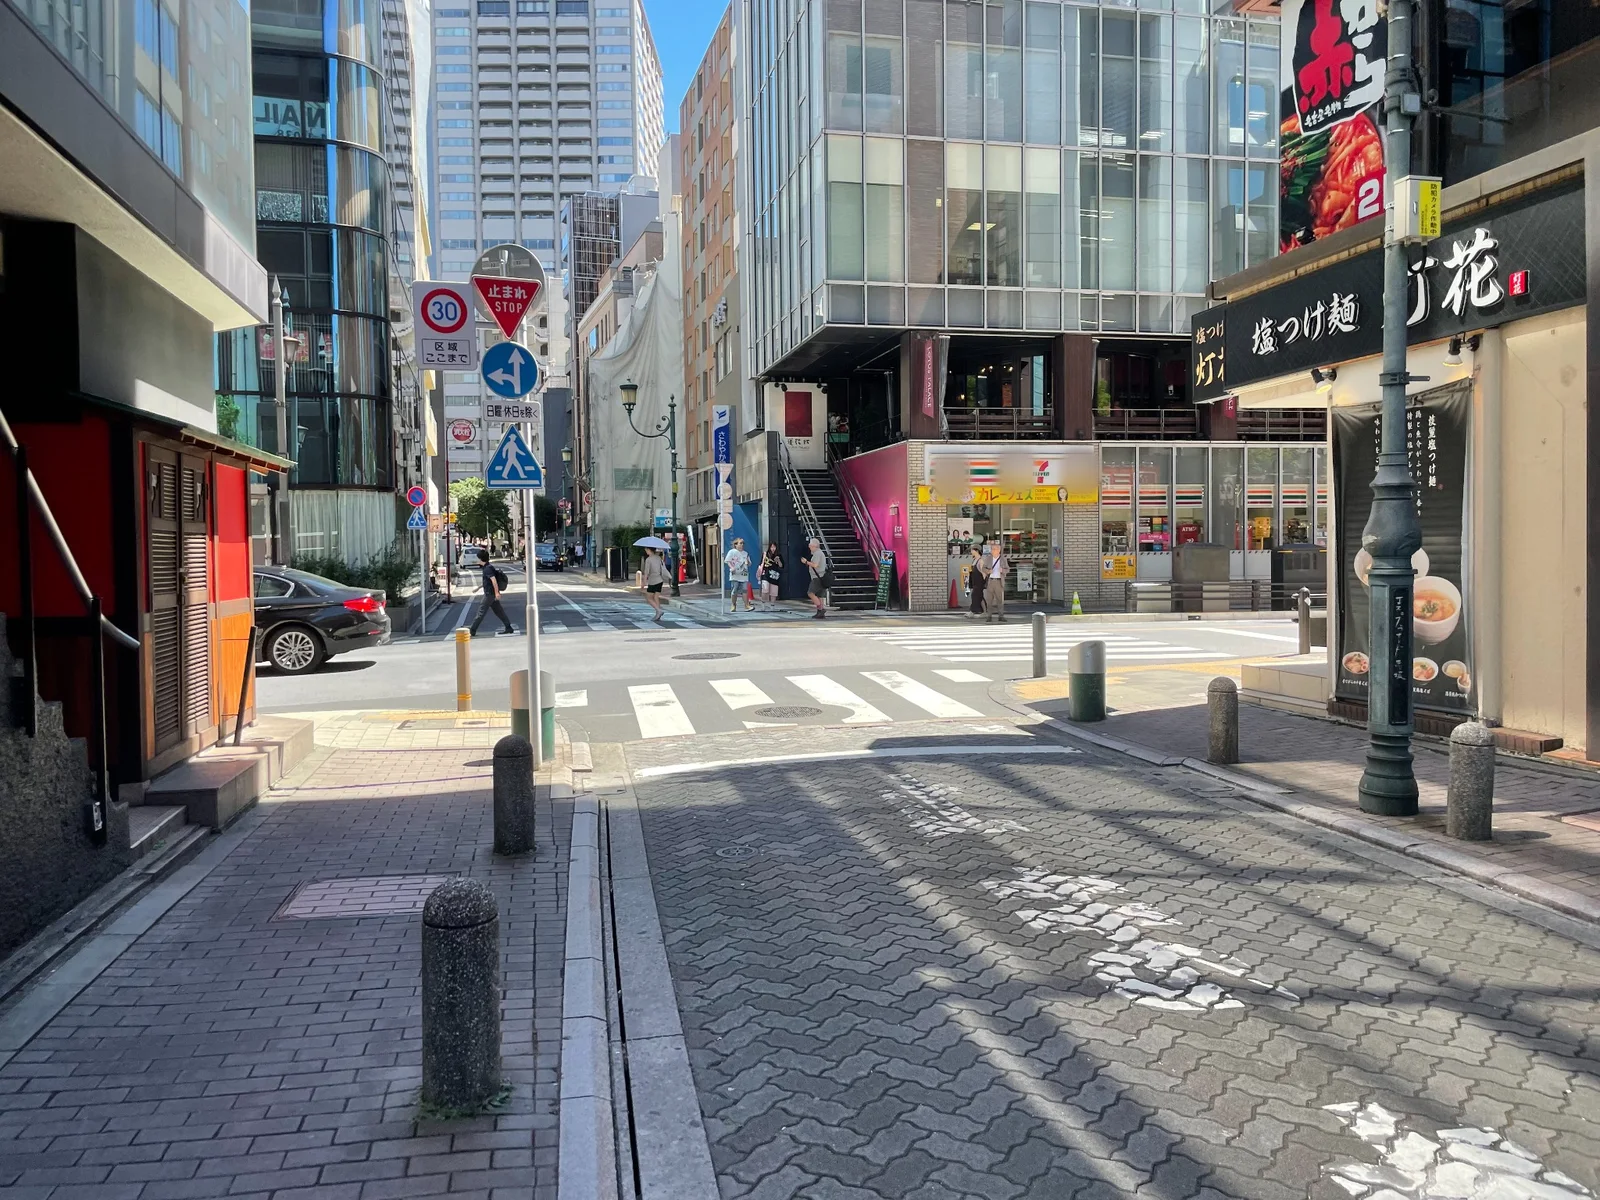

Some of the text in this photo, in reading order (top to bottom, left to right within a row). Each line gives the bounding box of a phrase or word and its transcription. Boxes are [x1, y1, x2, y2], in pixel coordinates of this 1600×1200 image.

[1430, 183, 1438, 235] 防犯カメラ作動中
[488, 284, 528, 299] 止まれ
[1512, 272, 1522, 294] 灯花
[432, 301, 458, 321] 30
[495, 301, 523, 313] STOP
[1252, 292, 1359, 355] 塩つけ麺
[434, 341, 458, 352] 区域
[425, 353, 468, 363] ここまで
[718, 431, 727, 462] さわやか
